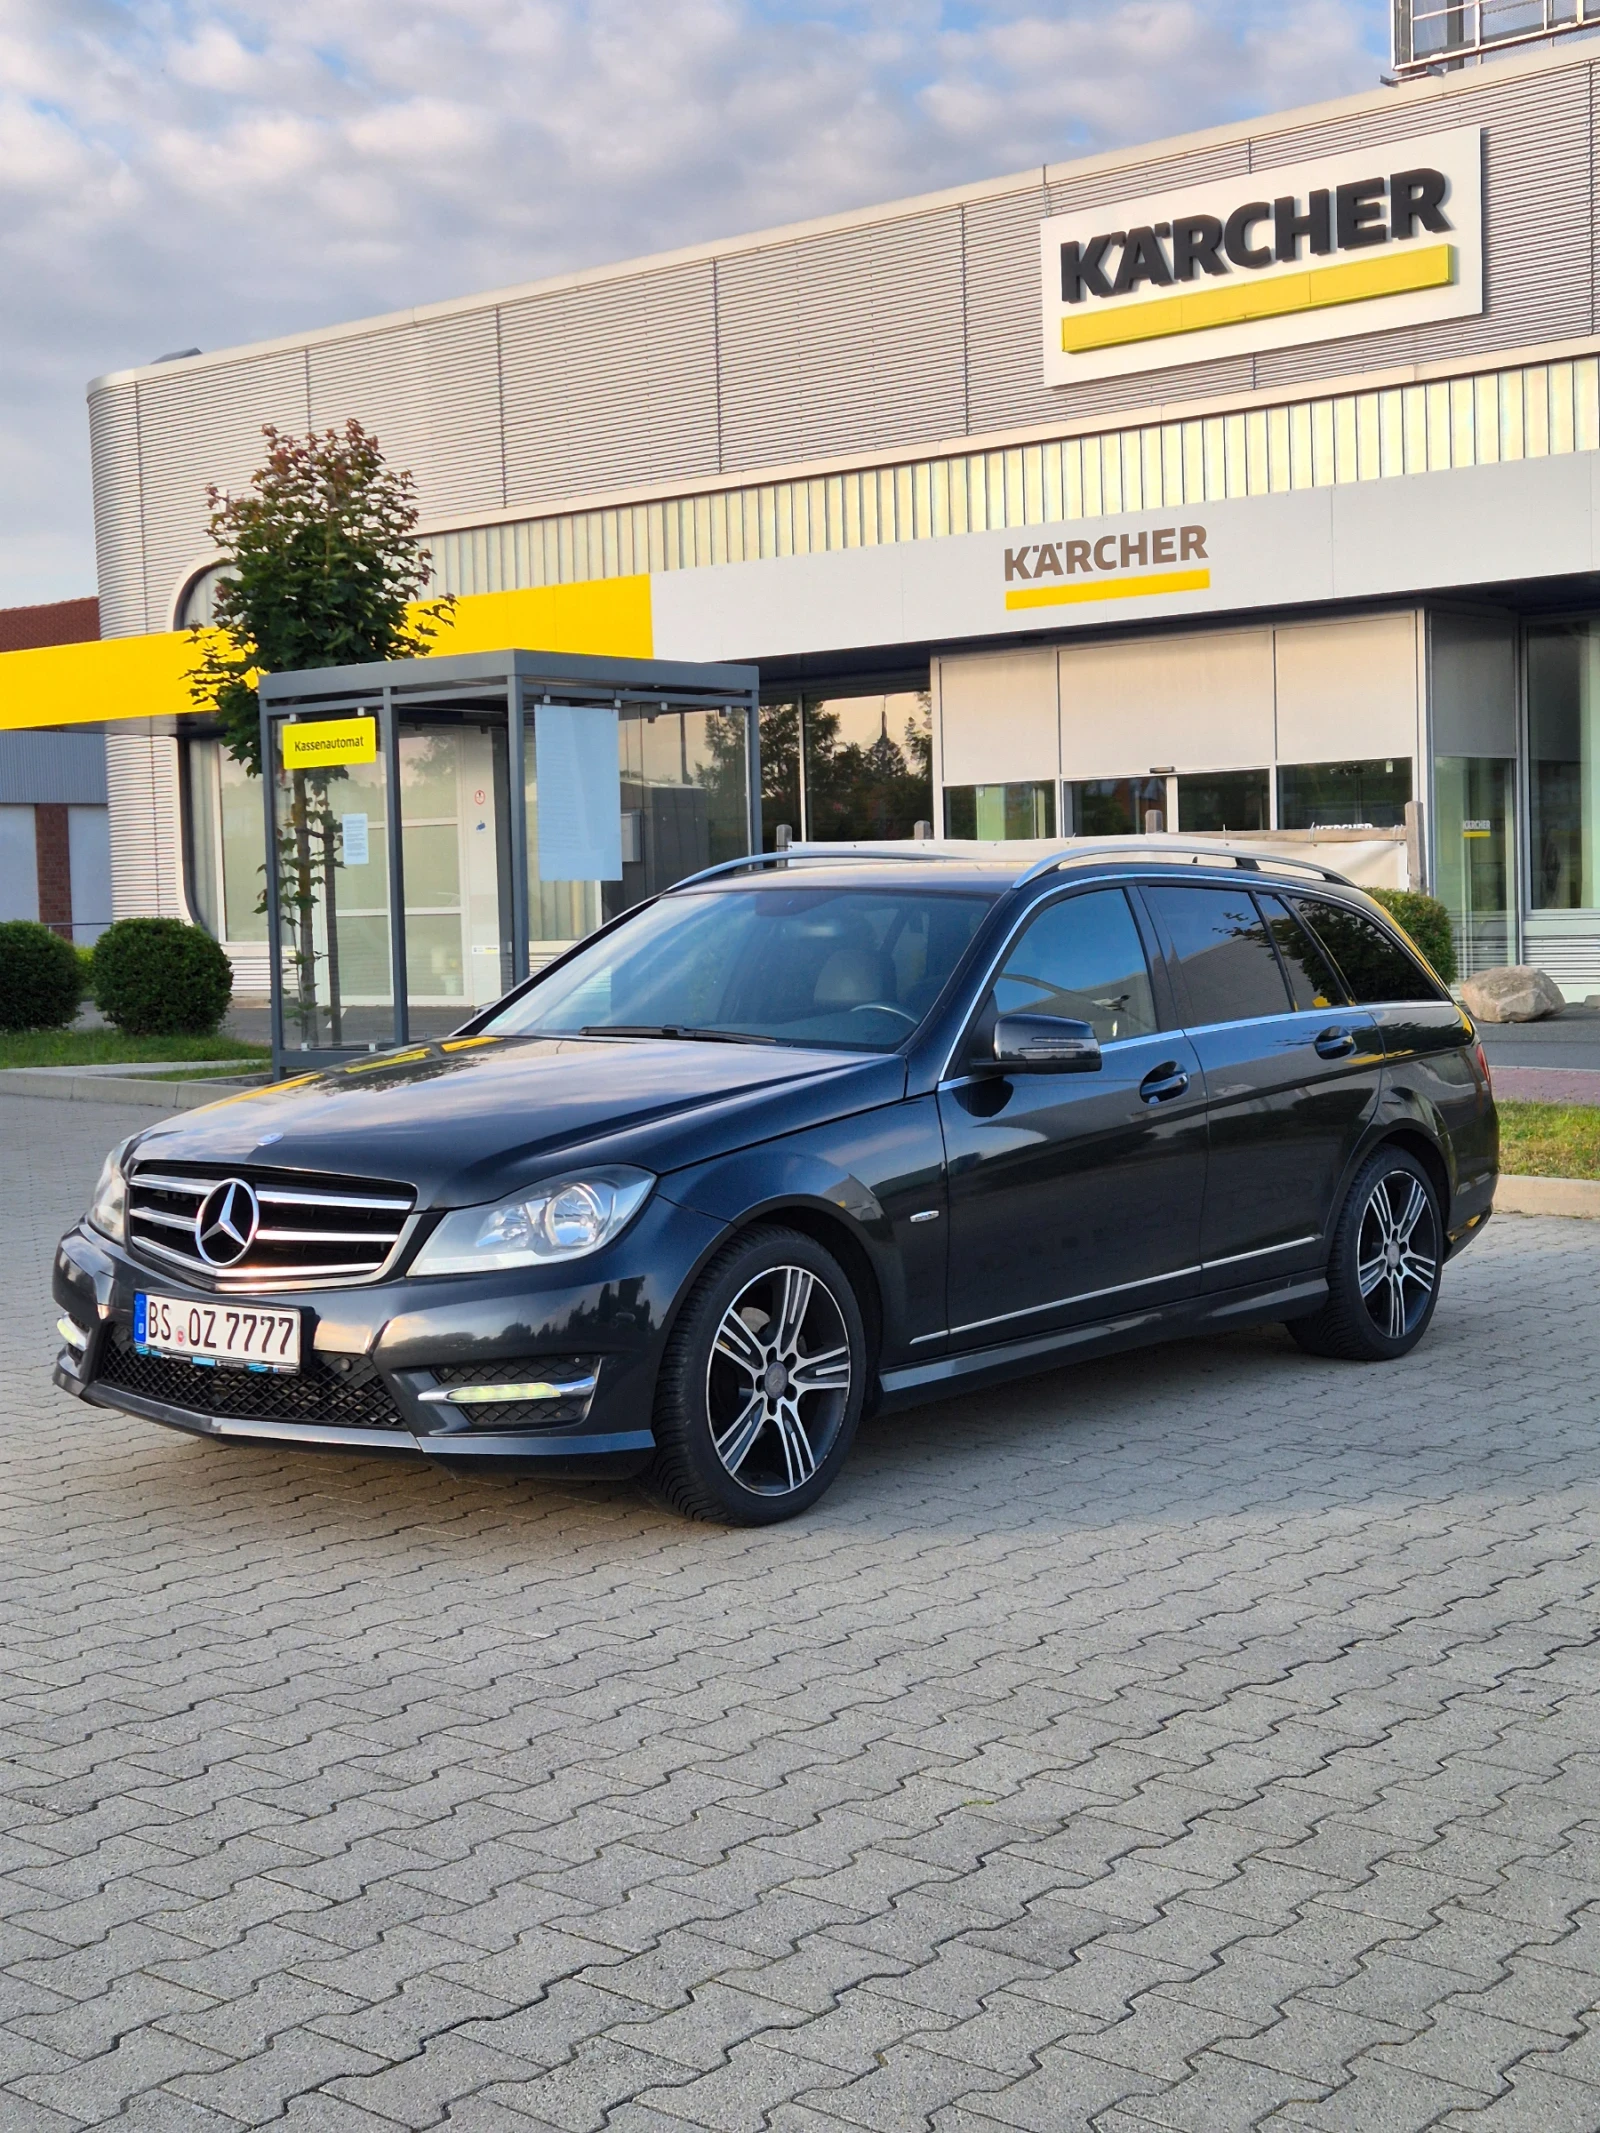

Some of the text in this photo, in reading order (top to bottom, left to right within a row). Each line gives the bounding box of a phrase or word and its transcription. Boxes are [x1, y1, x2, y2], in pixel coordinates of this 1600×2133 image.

[1060, 168, 1452, 303] KÄRCHER
[1004, 525, 1209, 581] KÄRCHER
[294, 736, 364, 752] Kassenautomat
[148, 1302, 294, 1355] BS OZ 7777
